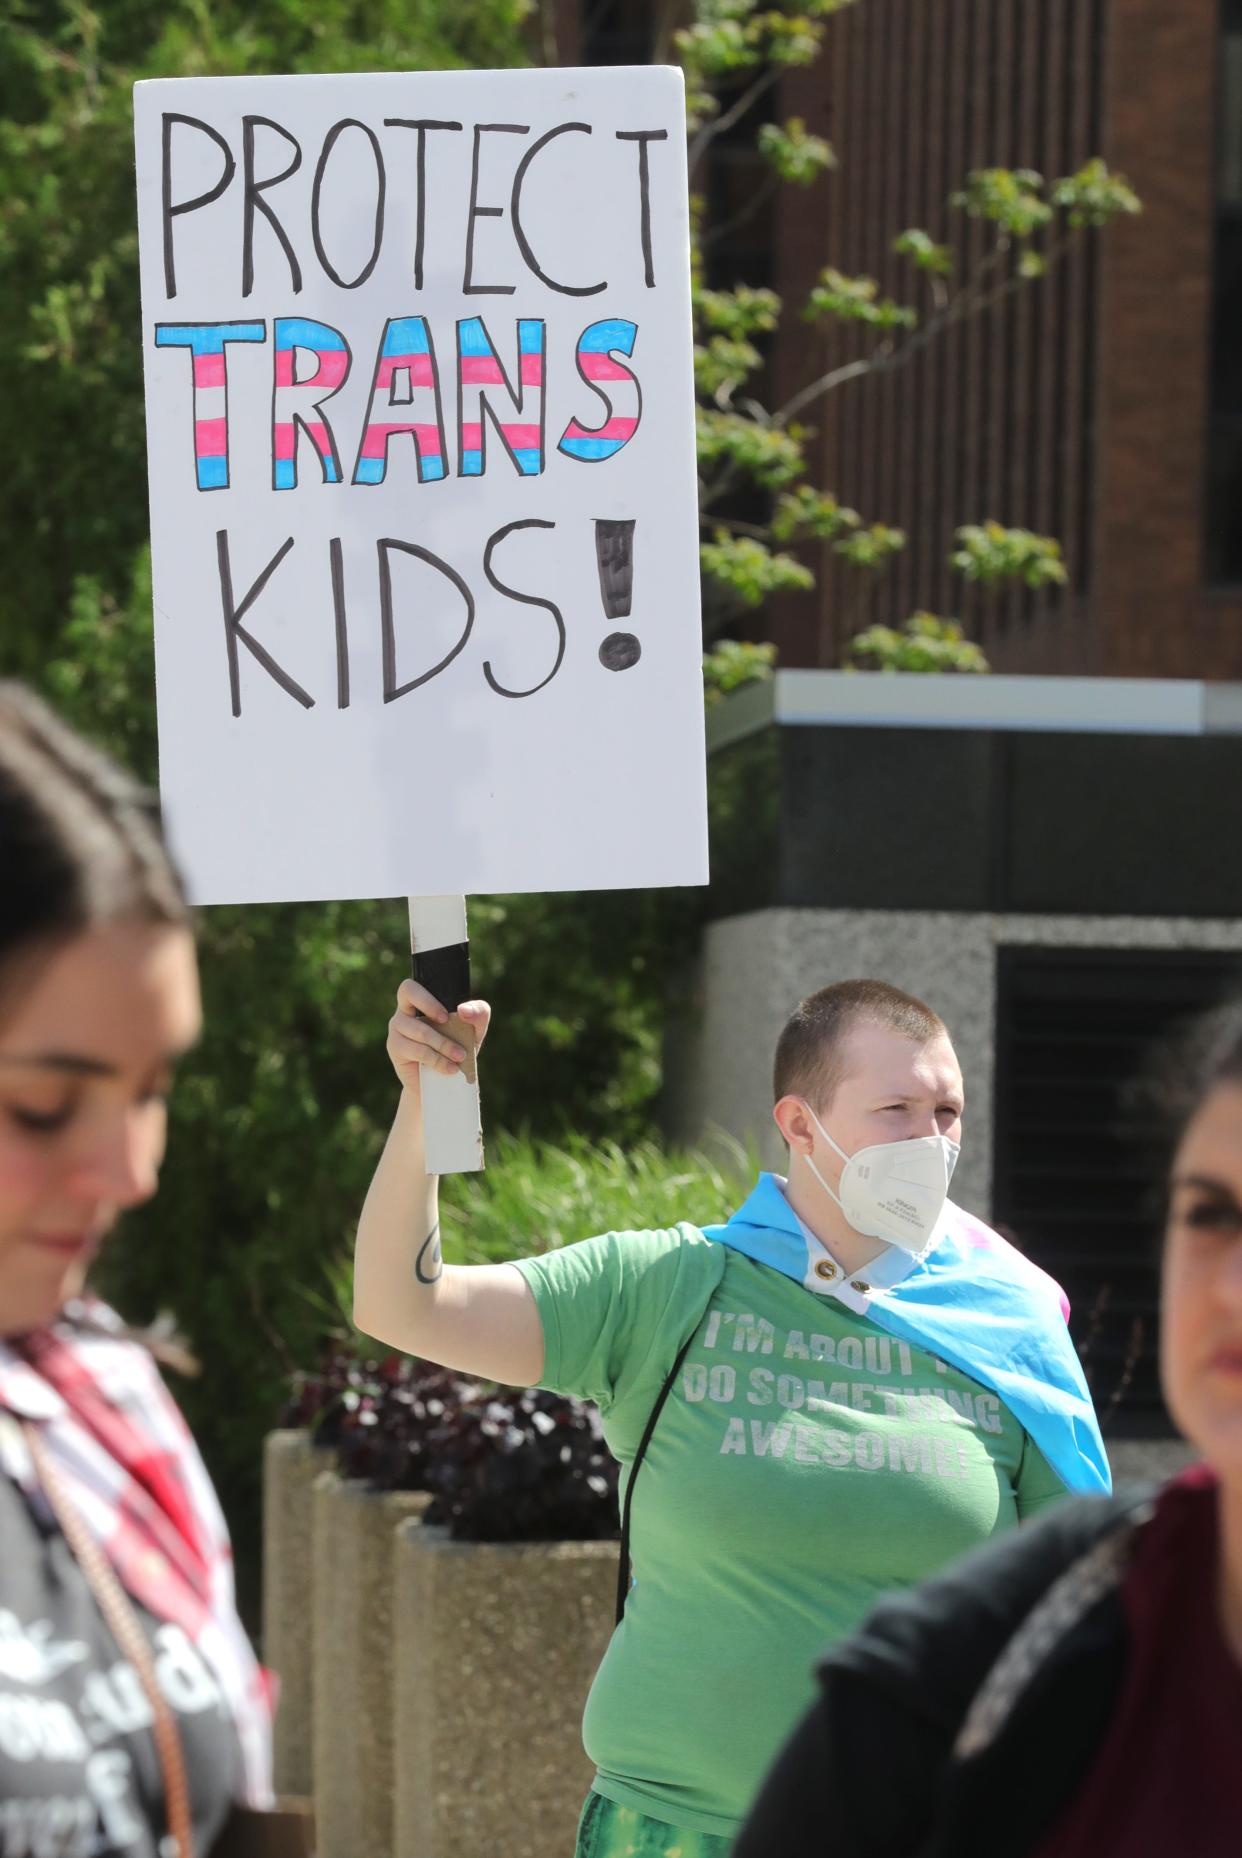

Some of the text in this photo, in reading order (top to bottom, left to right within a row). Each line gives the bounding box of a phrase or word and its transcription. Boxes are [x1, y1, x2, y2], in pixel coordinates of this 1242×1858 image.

[162, 112, 668, 298] PROTECT
[155, 315, 642, 491] TRANS
[216, 518, 642, 717] KIDS!
[683, 1363, 1003, 1434] DO SOMETHING
[703, 1310, 775, 1355] I'M
[783, 1330, 912, 1376] ABOUT
[720, 1417, 968, 1479] AWESOME!
